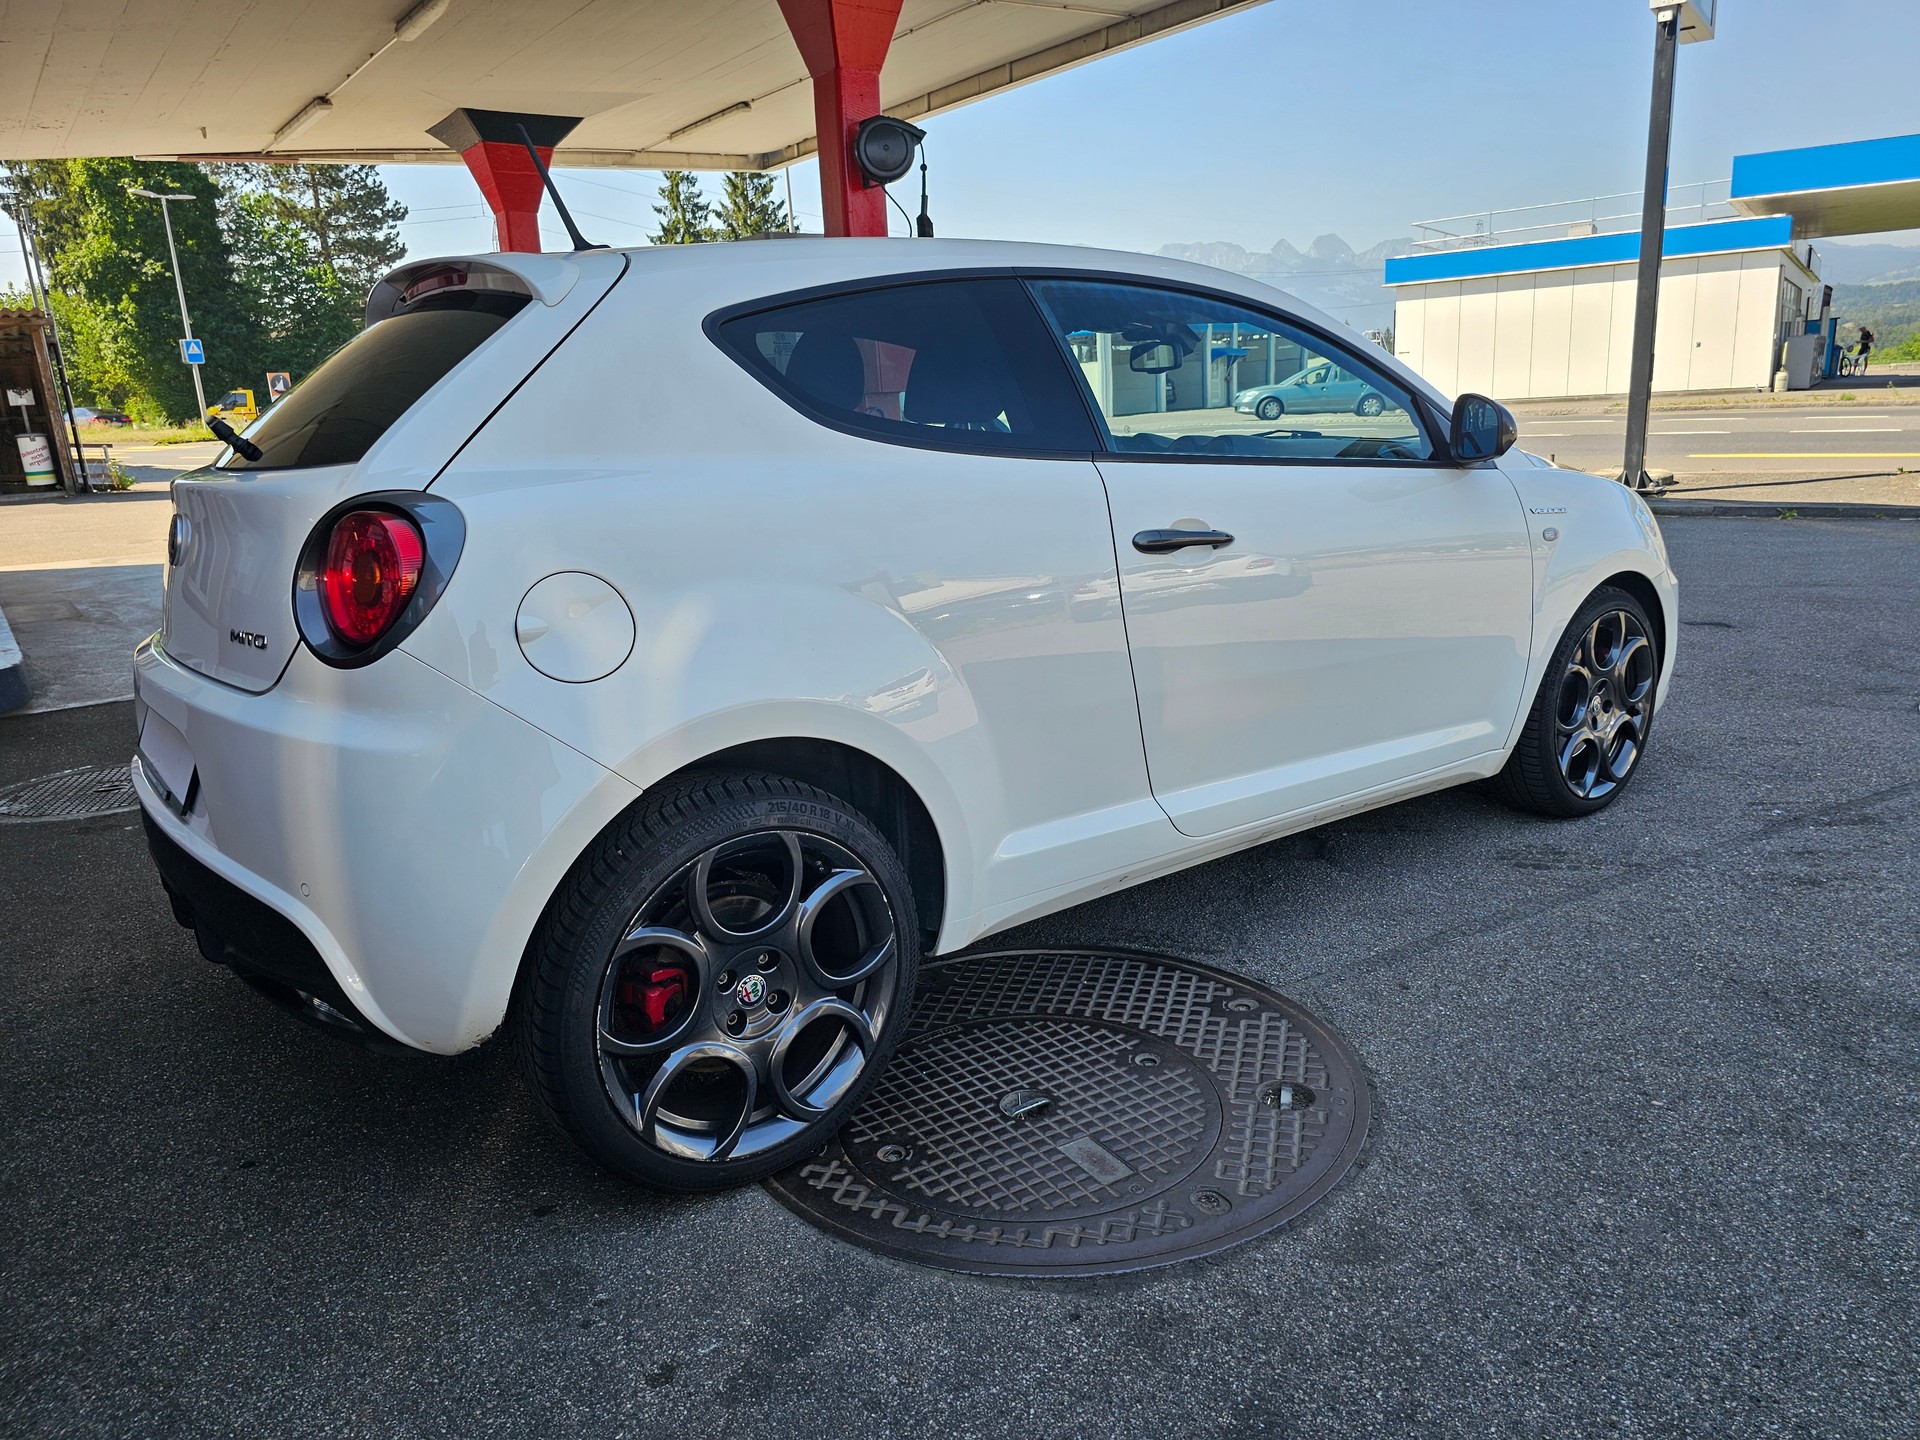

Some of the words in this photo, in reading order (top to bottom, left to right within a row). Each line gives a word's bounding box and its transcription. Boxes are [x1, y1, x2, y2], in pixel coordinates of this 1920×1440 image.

[230, 627, 269, 651] MITO
[767, 800, 807, 814] 215/40
[810, 804, 817, 816] R
[820, 806, 831, 820] 18
[834, 812, 842, 824] V
[844, 818, 857, 832] XL
